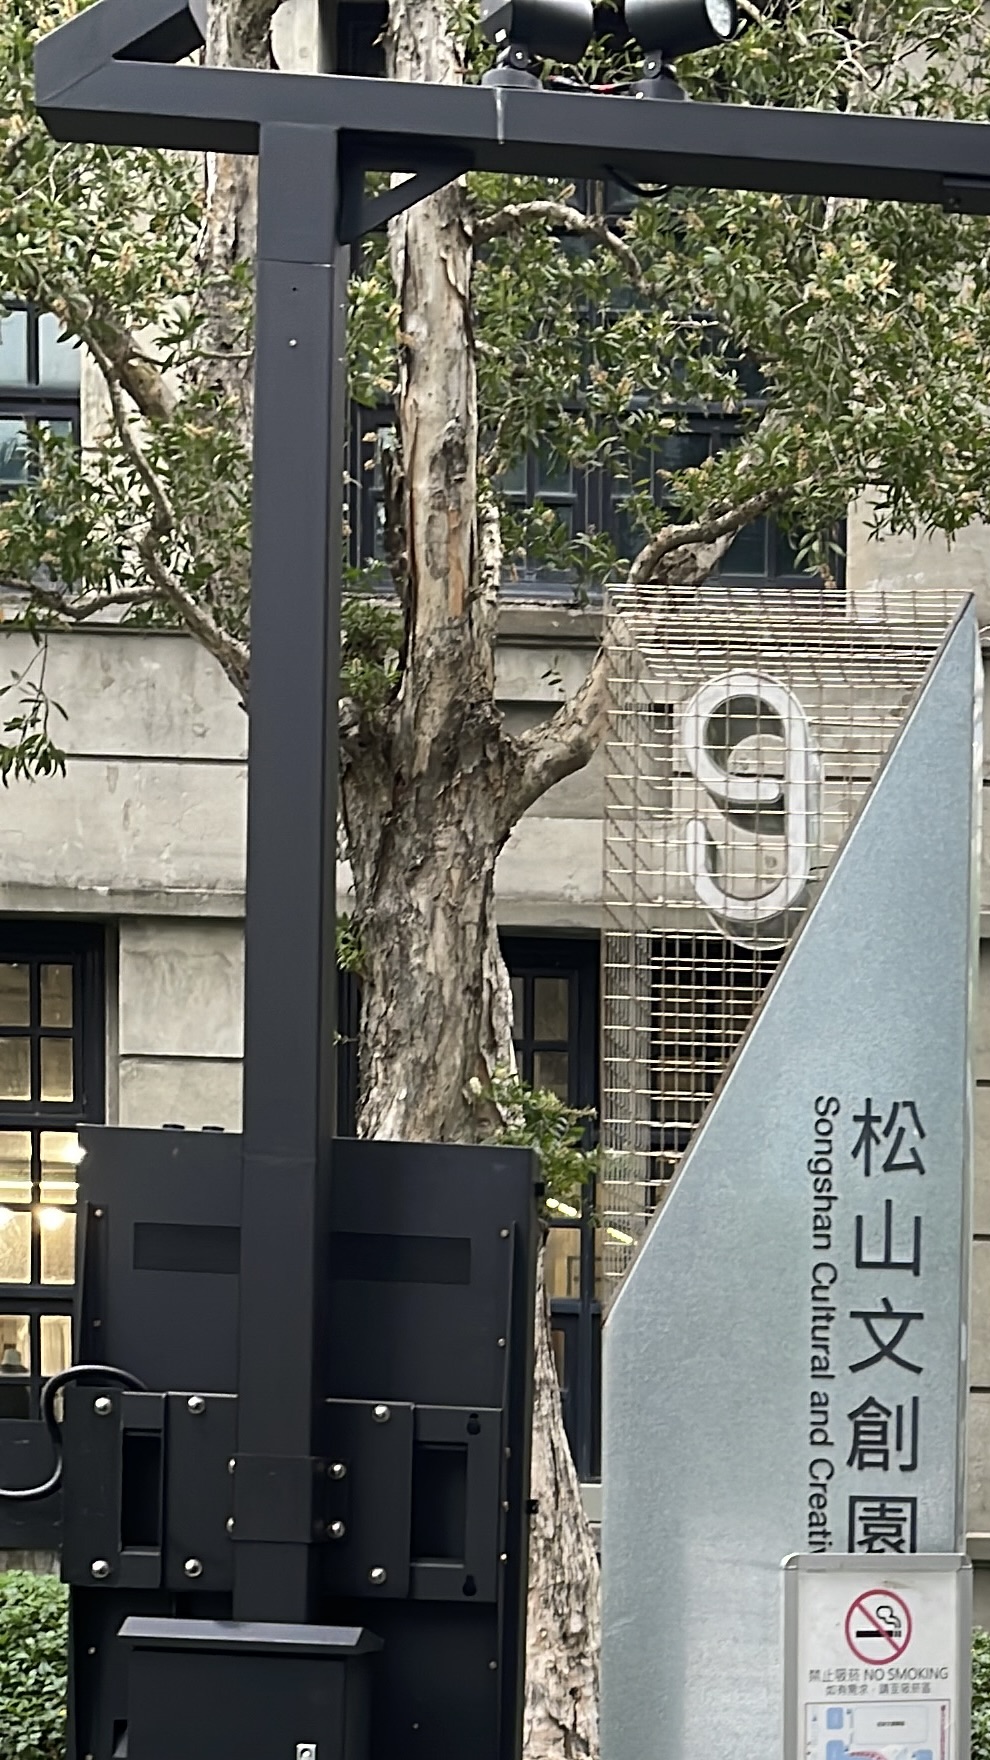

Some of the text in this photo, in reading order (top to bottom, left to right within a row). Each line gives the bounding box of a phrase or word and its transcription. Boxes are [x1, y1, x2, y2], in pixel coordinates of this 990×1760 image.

[680, 667, 809, 922] 9
[807, 1095, 841, 1250] Songshan
[810, 1261, 838, 1380] Cultural
[846, 1097, 926, 1553] 松山文創園
[809, 1390, 835, 1446] and
[864, 1667, 885, 1681] NO
[887, 1666, 949, 1681] SMOKING
